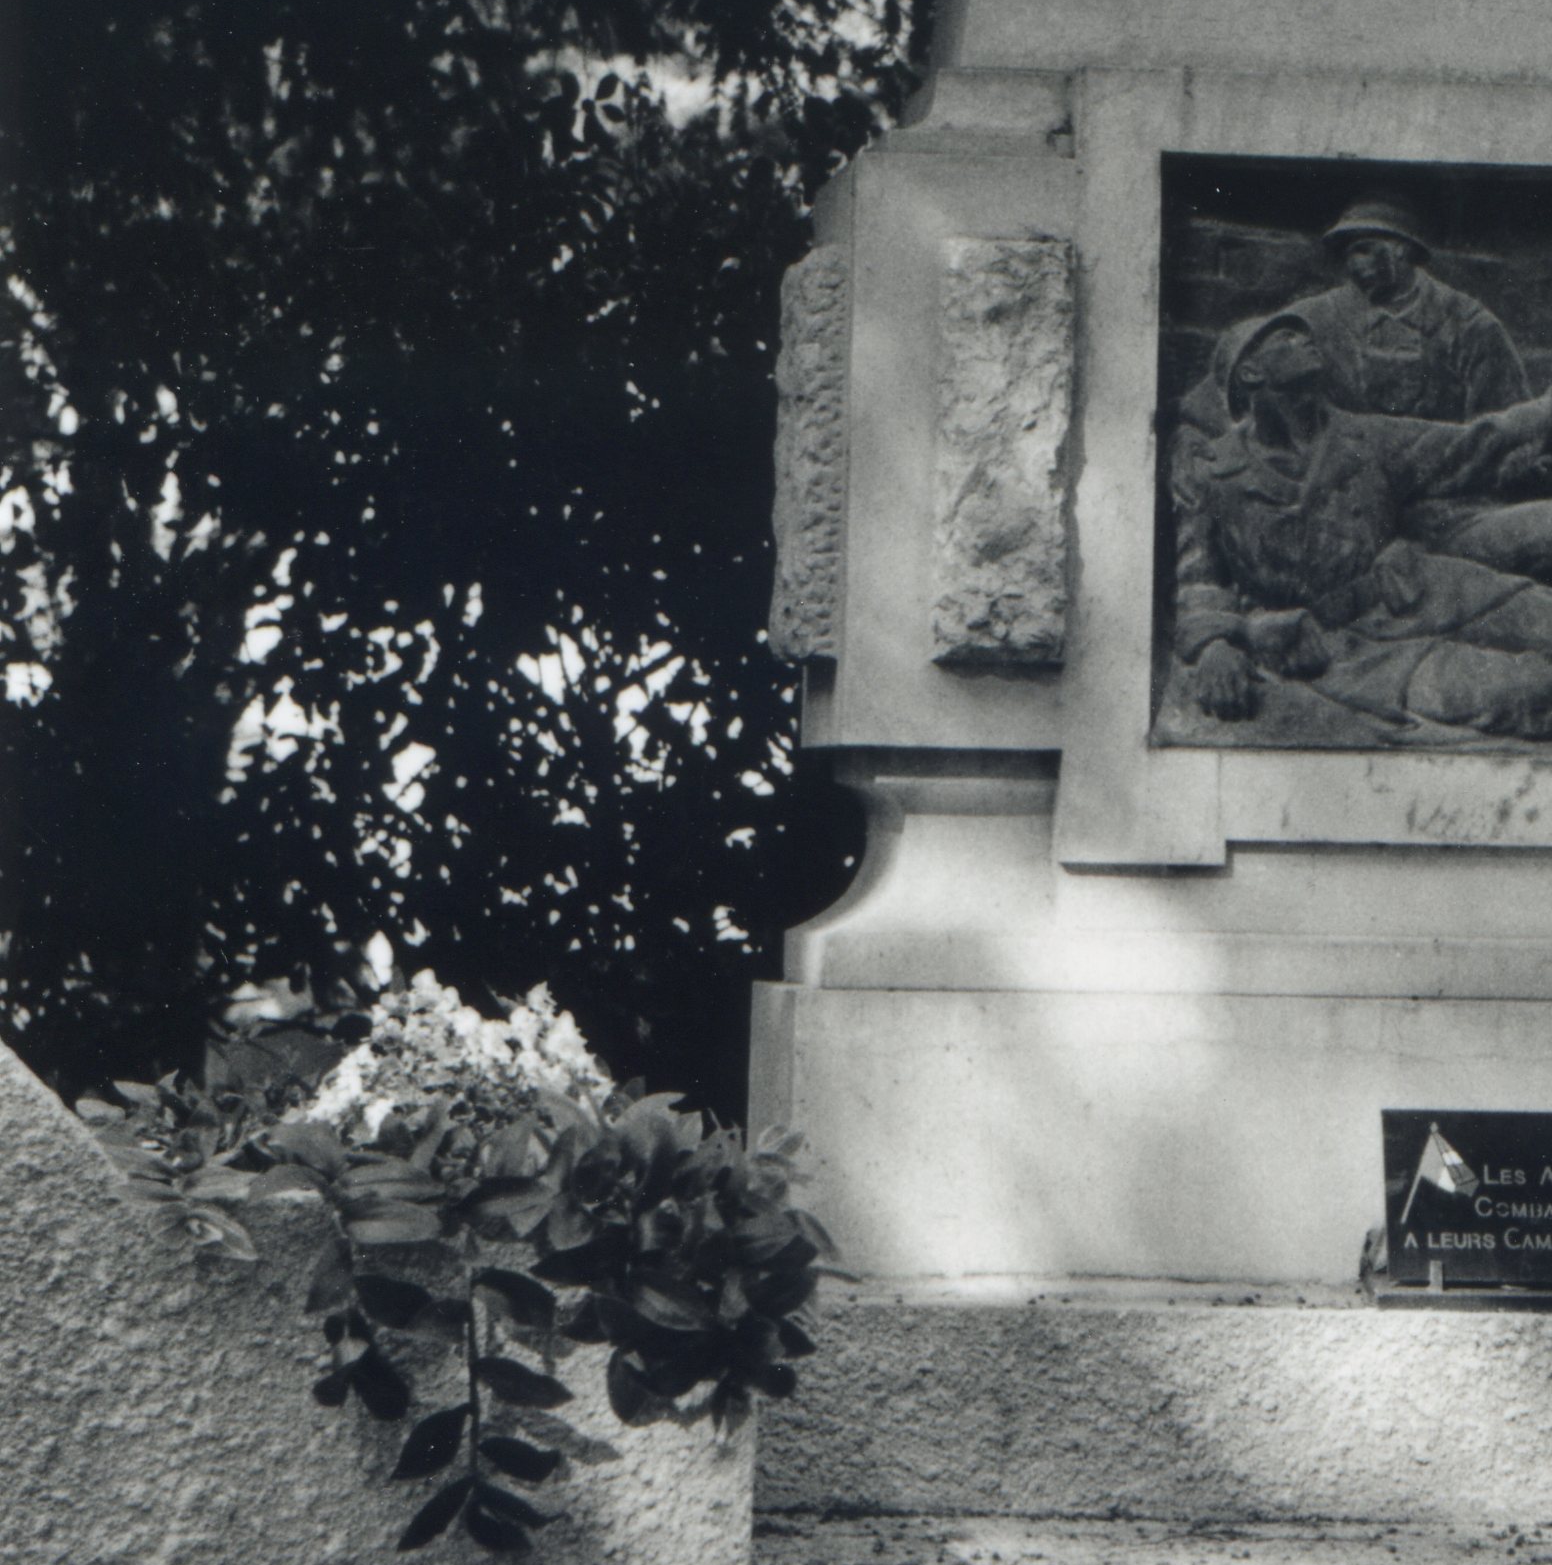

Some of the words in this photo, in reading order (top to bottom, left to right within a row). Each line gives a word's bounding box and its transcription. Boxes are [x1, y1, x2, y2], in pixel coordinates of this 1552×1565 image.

[1484, 1165, 1526, 1184] LES
[1404, 1233, 1418, 1248] A
[1428, 1232, 1495, 1249] LEURS
